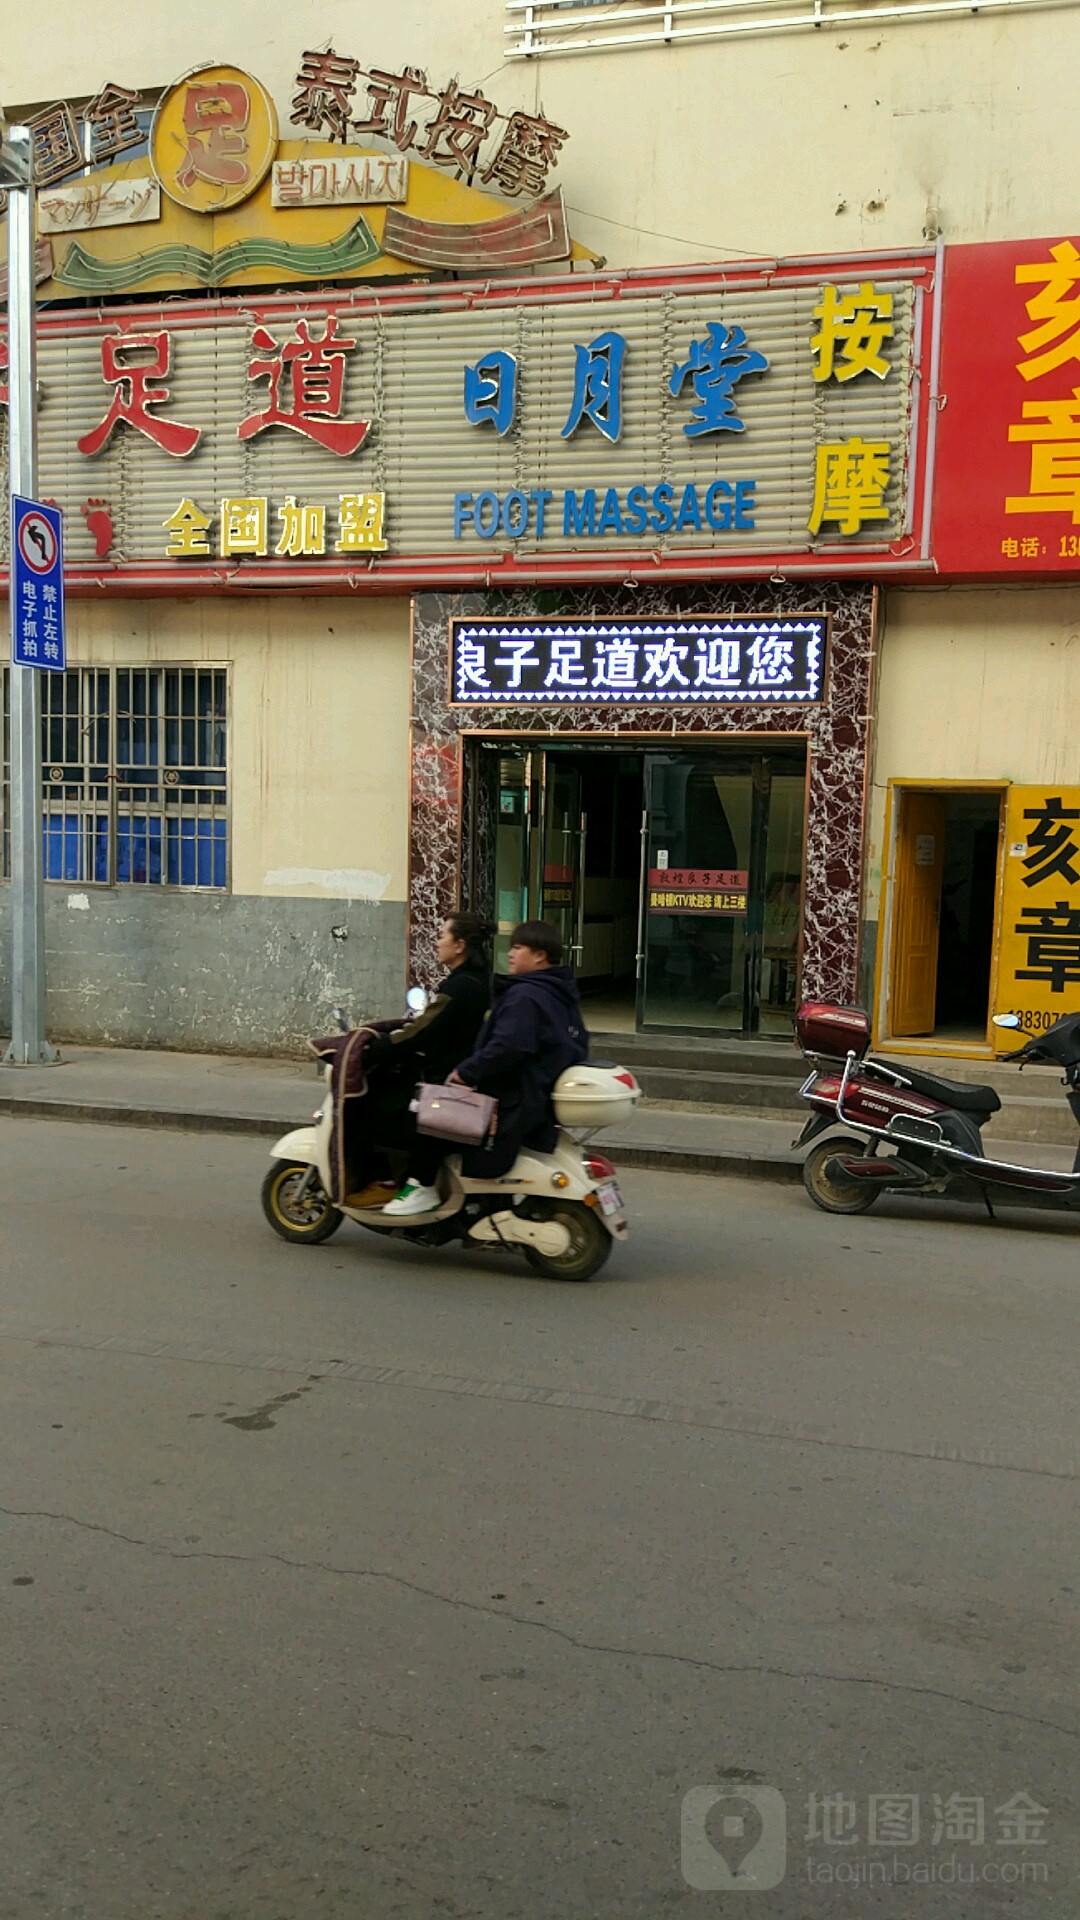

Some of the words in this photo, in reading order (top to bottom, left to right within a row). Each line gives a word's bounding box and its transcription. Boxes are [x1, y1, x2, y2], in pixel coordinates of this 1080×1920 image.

[174, 80, 250, 189] 足
[289, 47, 571, 198] 泰式按摩
[276, 158, 406, 202] 발마사지
[463, 321, 768, 443] 日月堂
[807, 282, 896, 538] 按摩
[162, 491, 389, 557] 全国加盟
[454, 489, 553, 539] FOOT
[562, 480, 755, 536] MASSAGE
[1001, 537, 1047, 558] 电话：
[1058, 535, 1080, 557] 13
[22, 580, 38, 658] 电子抓拍
[42, 584, 59, 661] 禁止左转
